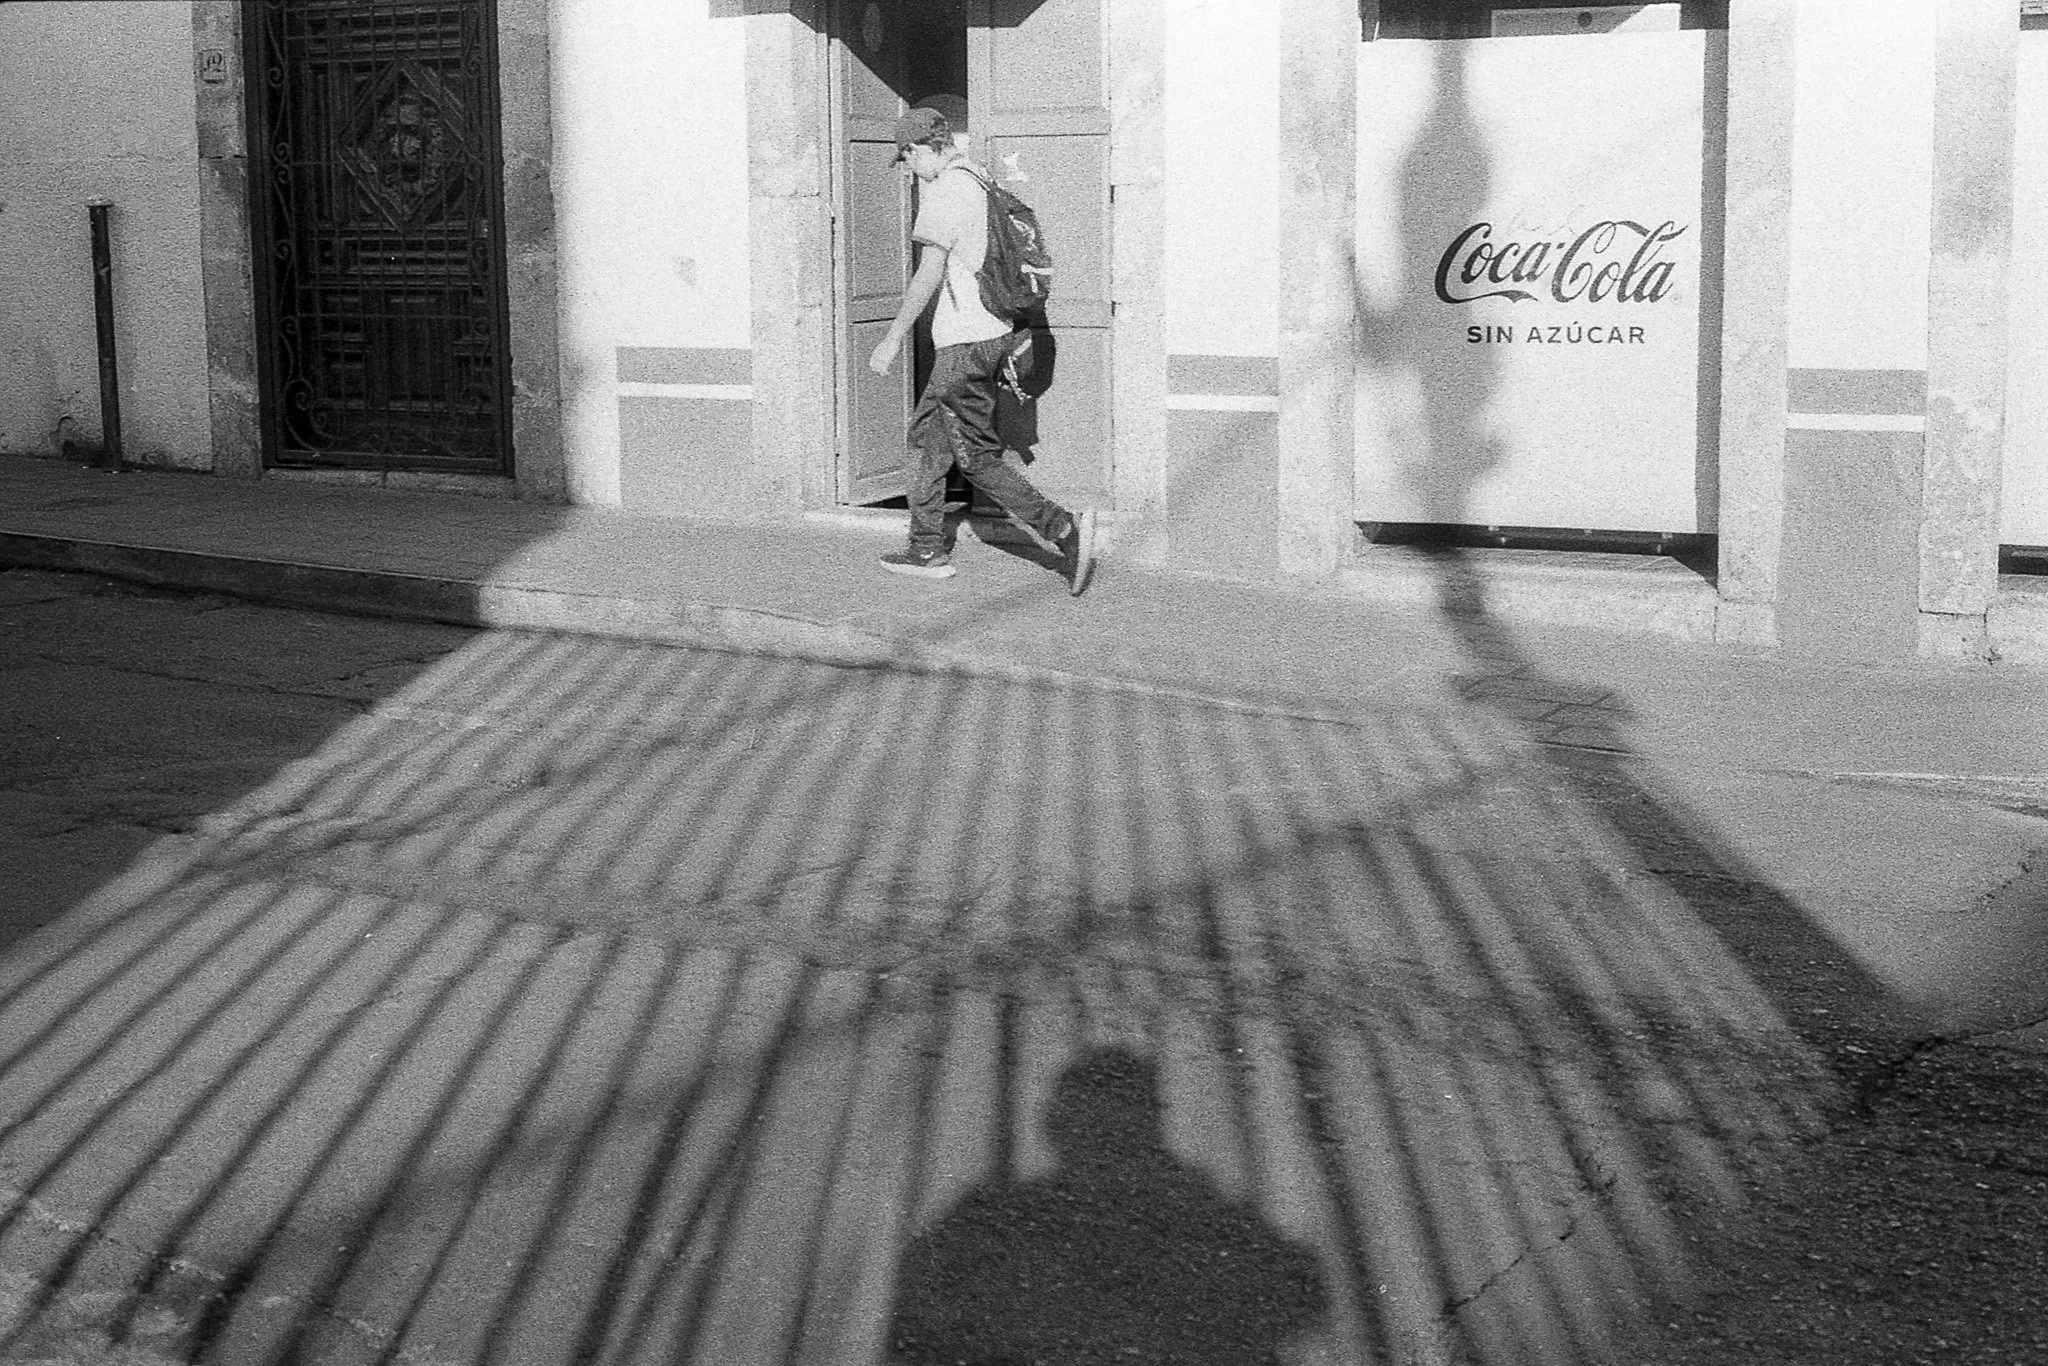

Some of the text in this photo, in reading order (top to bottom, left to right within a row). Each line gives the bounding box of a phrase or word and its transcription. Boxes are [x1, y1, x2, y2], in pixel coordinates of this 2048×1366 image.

[1434, 220, 1690, 304] Coca-Cola
[1467, 320, 1646, 345] SIN AZÚCAR
